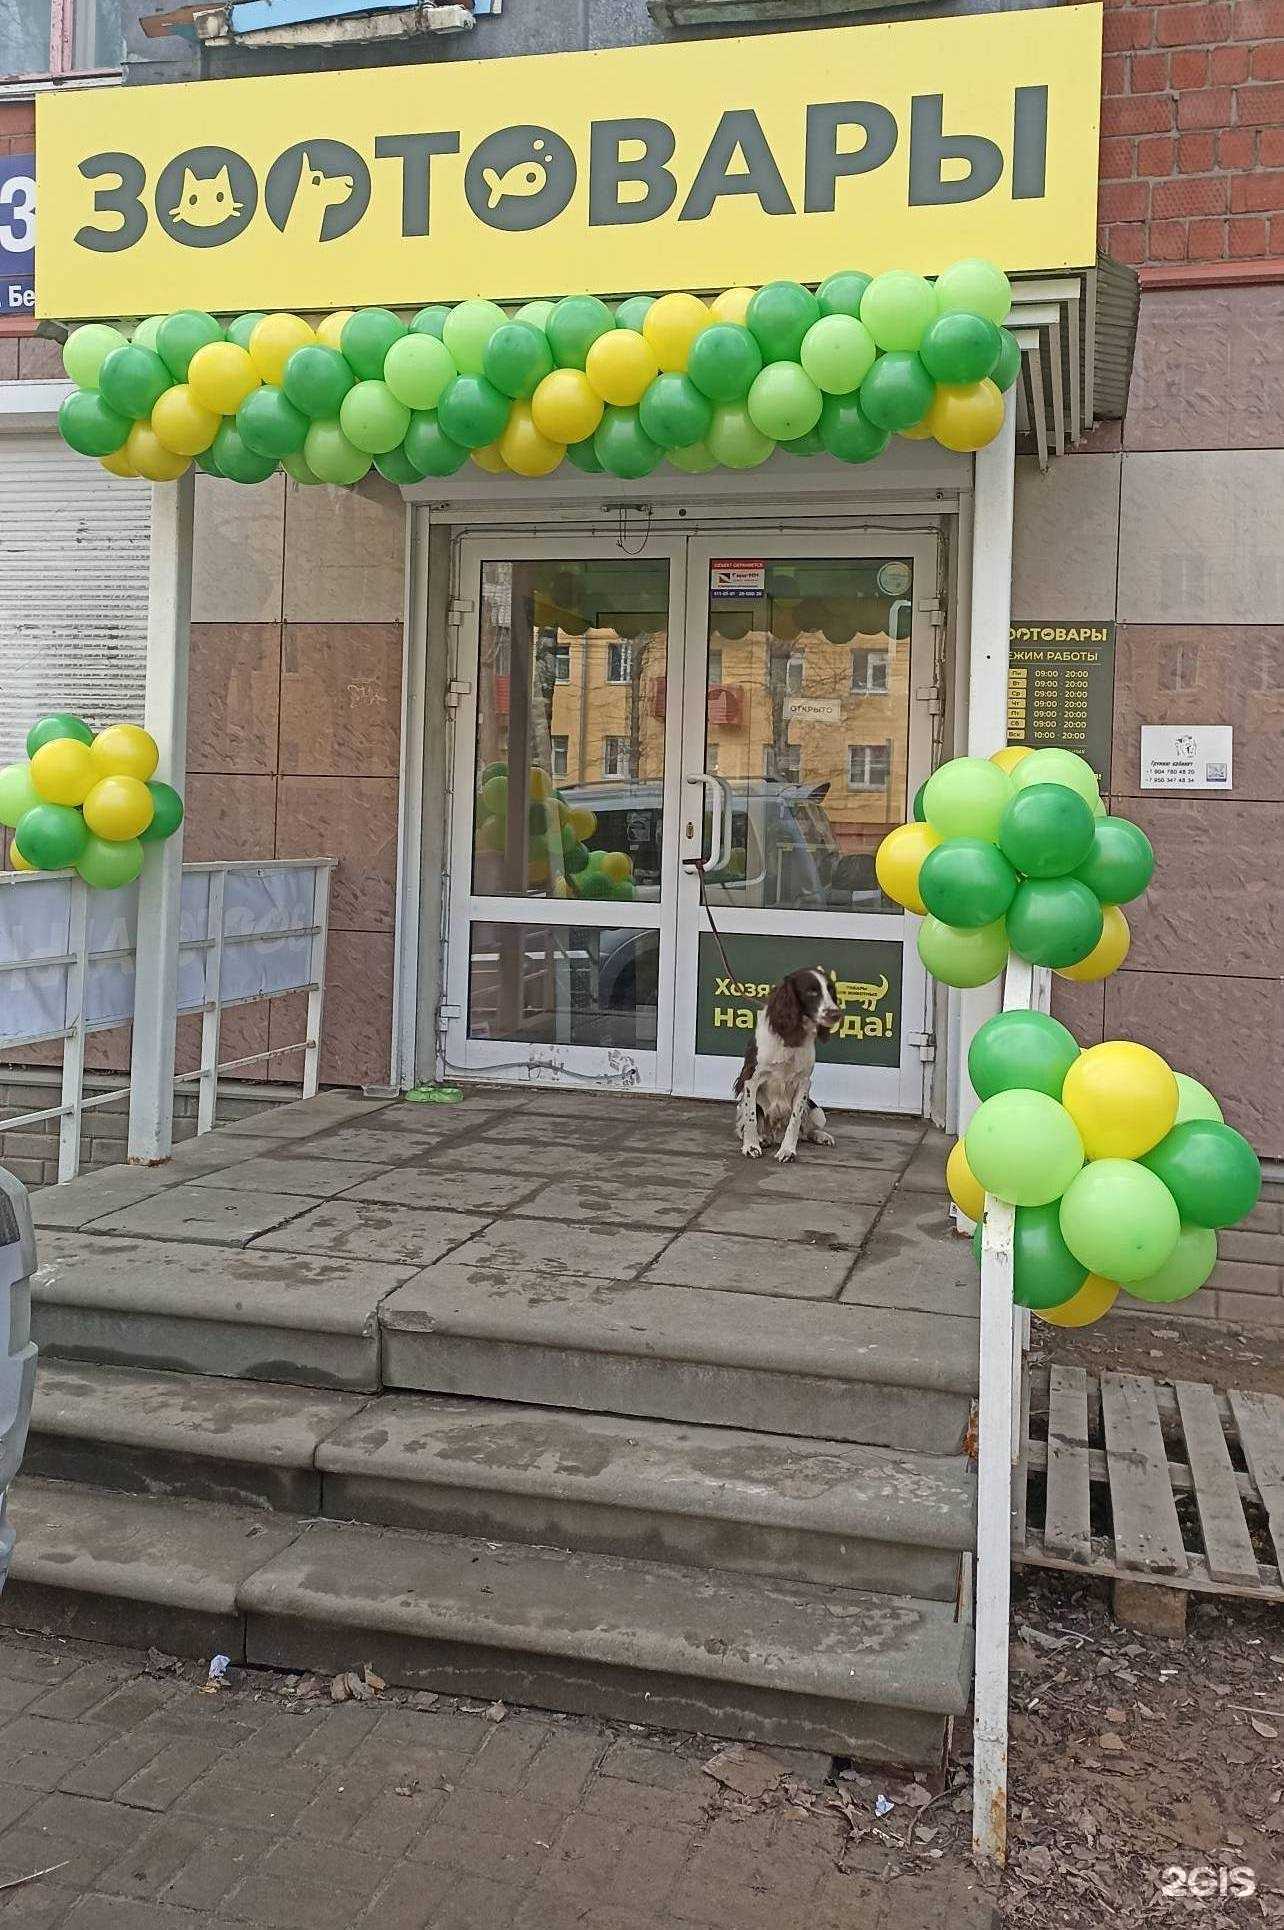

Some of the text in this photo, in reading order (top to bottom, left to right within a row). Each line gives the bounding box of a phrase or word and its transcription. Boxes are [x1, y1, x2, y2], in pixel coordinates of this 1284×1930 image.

[73, 84, 1049, 253] ЗООТОВАРЫ
[8, 285, 35, 307] Бе
[1009, 651, 1098, 661] ЕЖИМ РАБОТЫ
[1035, 670, 1059, 678] 09:00
[1065, 670, 1089, 678] 20:00
[1034, 680, 1058, 688] 09:00
[1065, 680, 1088, 688] 20:00
[1034, 690, 1058, 698] 09:00
[1065, 690, 1088, 698] 20:00
[1064, 700, 1088, 708] 20:00
[790, 705, 833, 713] ОТКРЫТО
[1033, 710, 1057, 718] 09:00
[1034, 731, 1055, 739] 10:00
[714, 977, 776, 997] Хозя
